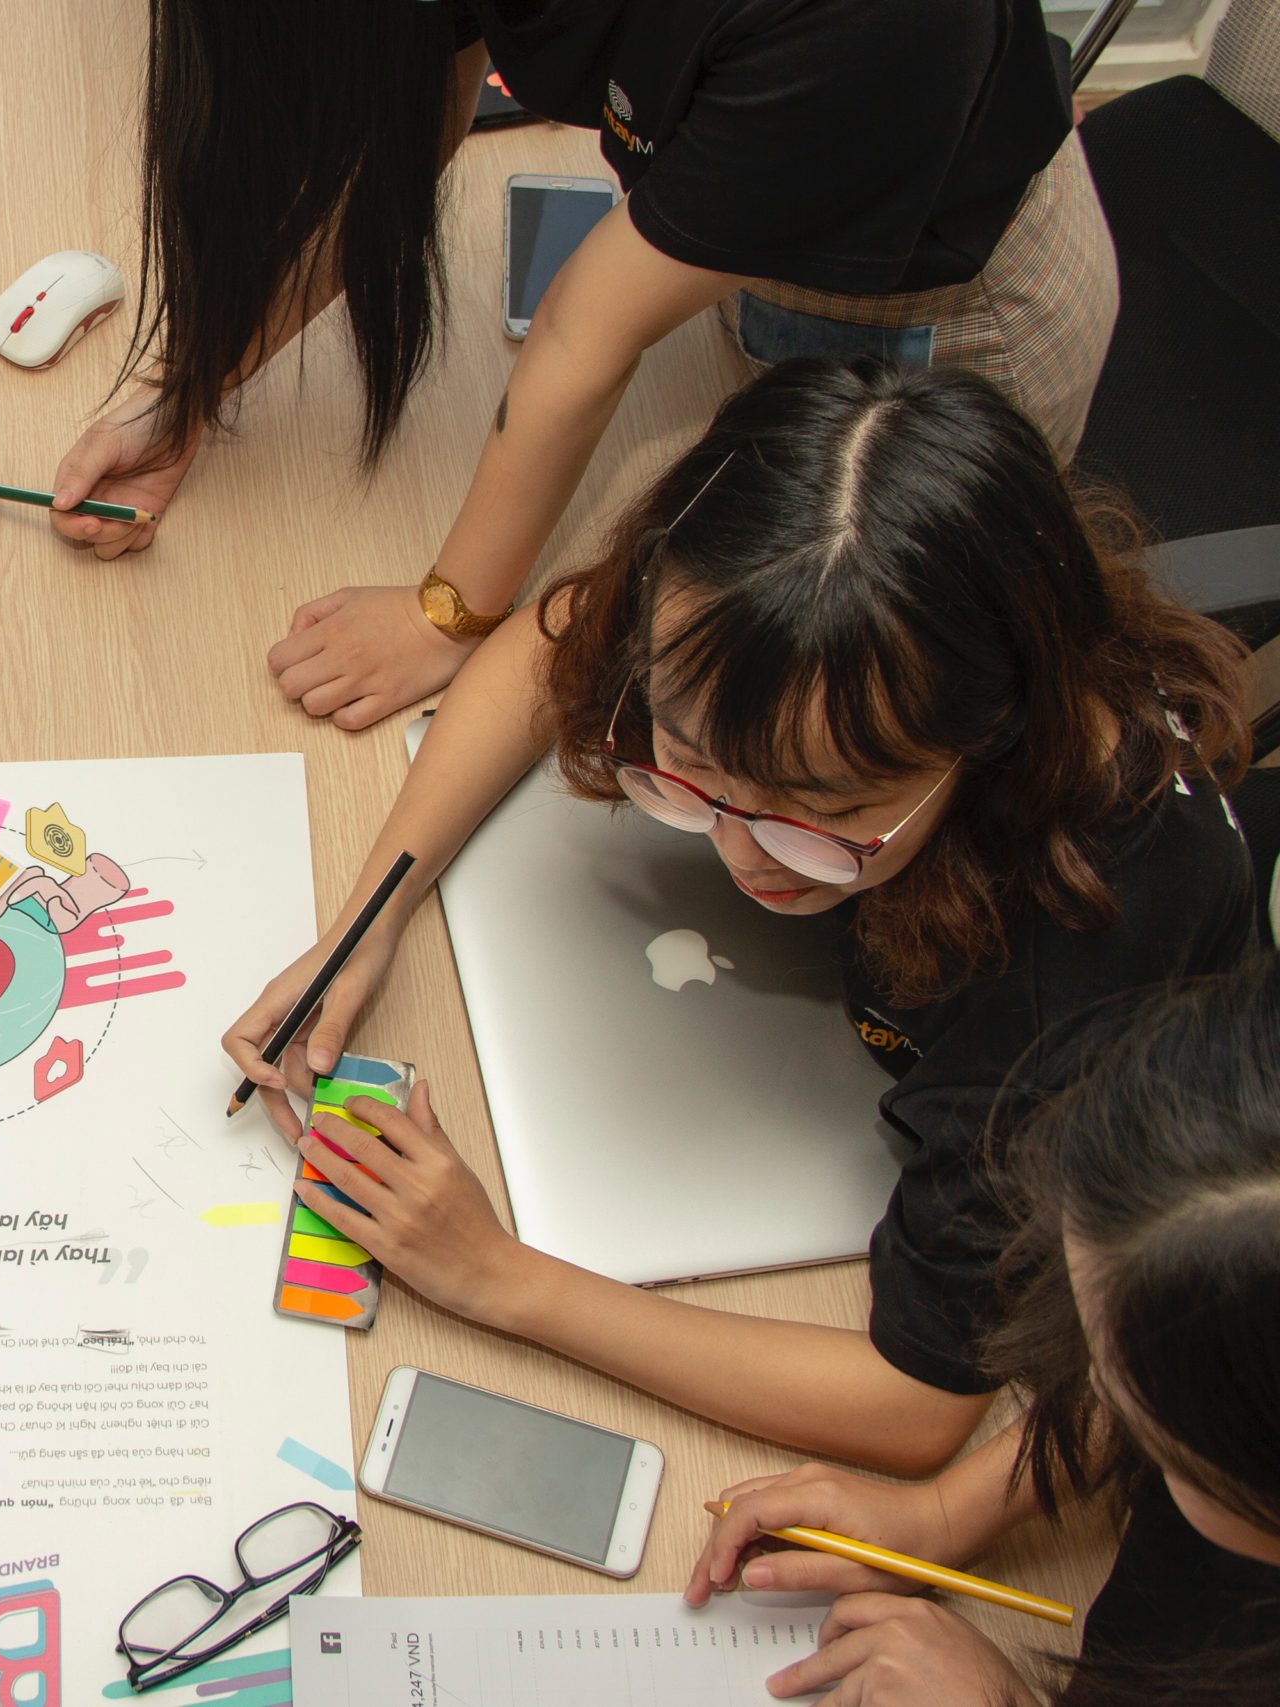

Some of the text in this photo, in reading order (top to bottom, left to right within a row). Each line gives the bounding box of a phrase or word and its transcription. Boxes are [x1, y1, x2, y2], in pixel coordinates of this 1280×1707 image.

[25, 1209, 68, 1234] hãy
[30, 1248, 50, 1268] vì
[57, 1244, 112, 1266] Thay
[150, 1362, 170, 1373] bay
[173, 1363, 190, 1373] chi
[38, 1382, 59, 1394] bay
[105, 1383, 129, 1393] nhe!
[136, 1399, 165, 1409] xong
[189, 1400, 209, 1410] ha?
[100, 1418, 143, 1430] nghen?
[159, 1477, 180, 1487] cho
[103, 1496, 131, 1506] xong
[407, 1633, 420, 1666] VND
